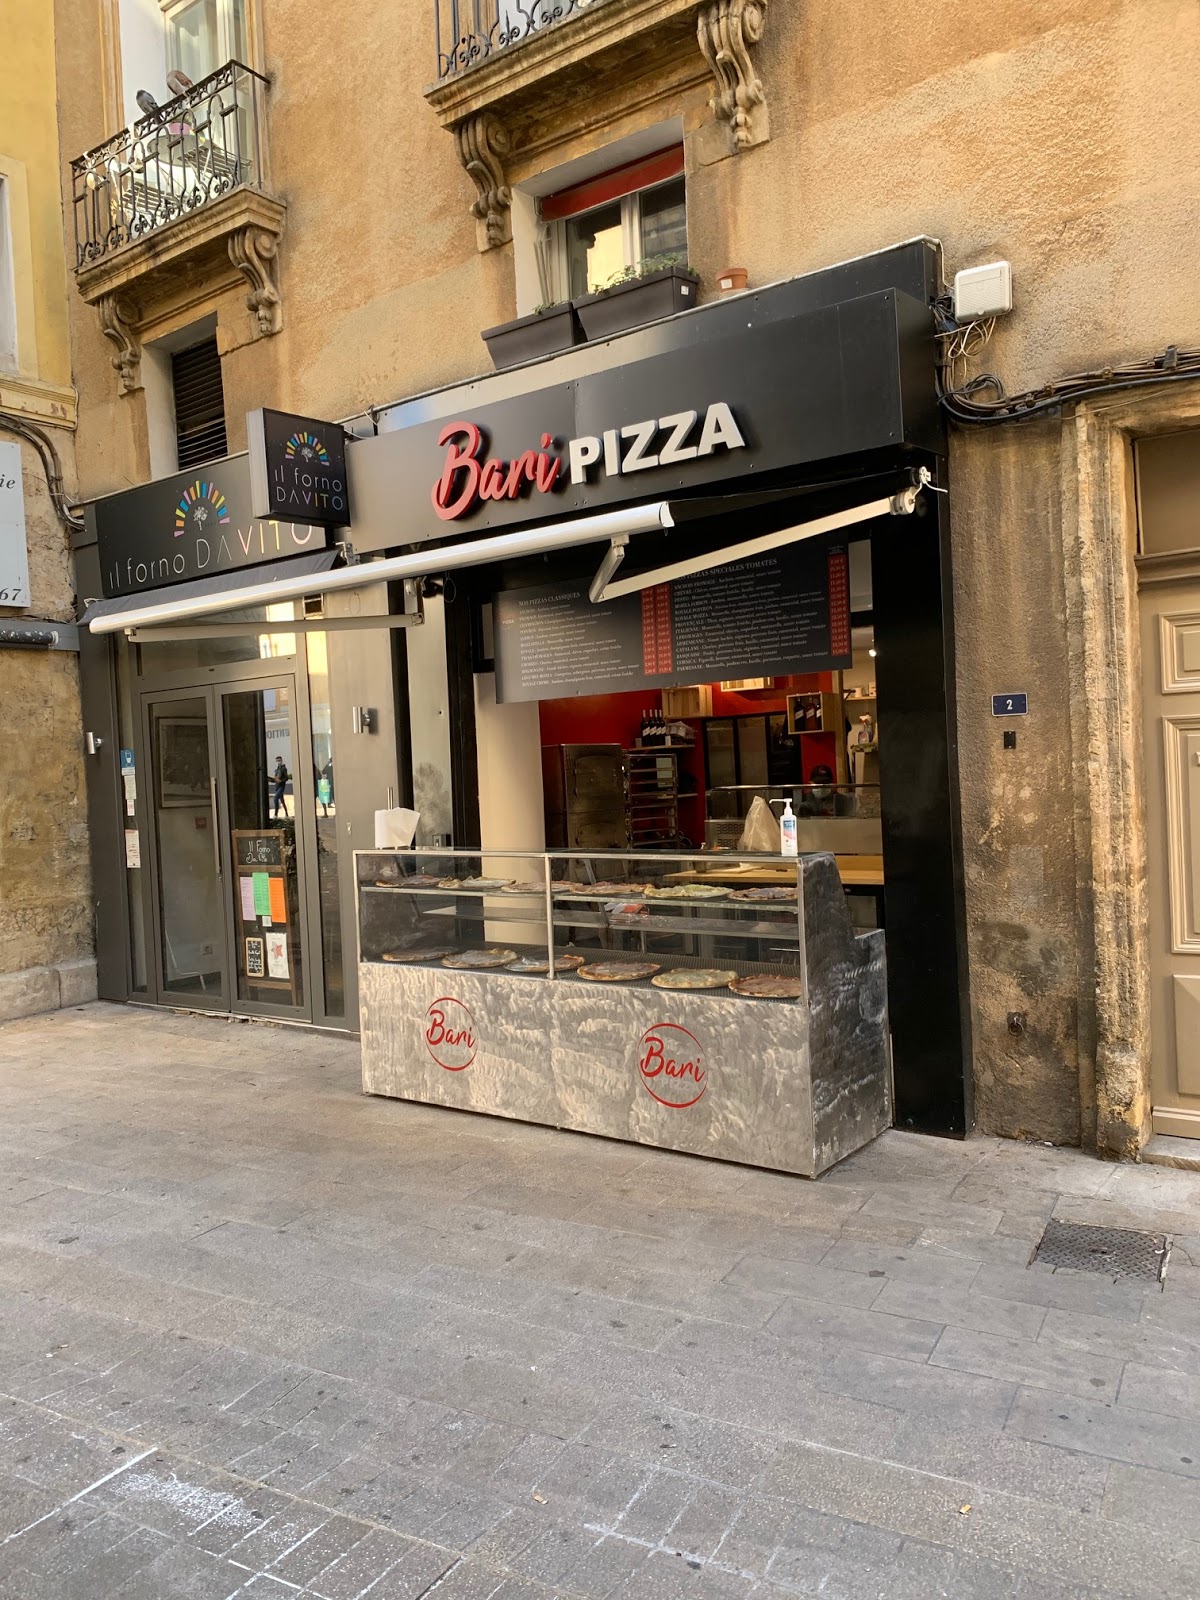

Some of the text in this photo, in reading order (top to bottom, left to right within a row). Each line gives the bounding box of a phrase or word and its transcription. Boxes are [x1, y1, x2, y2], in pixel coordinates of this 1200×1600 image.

[431, 402, 745, 520] Bari PIZZA
[294, 467, 342, 492] forno
[276, 486, 343, 510] DAVITO
[127, 554, 185, 585] forno
[196, 520, 312, 568] DAVITO
[710, 565, 745, 574] SPECIALES
[746, 558, 777, 569] TOMATES
[529, 597, 548, 605] PIZZAS
[1006, 699, 1013, 710] 2
[426, 1009, 476, 1048] Bari
[640, 1037, 705, 1082] Bari
